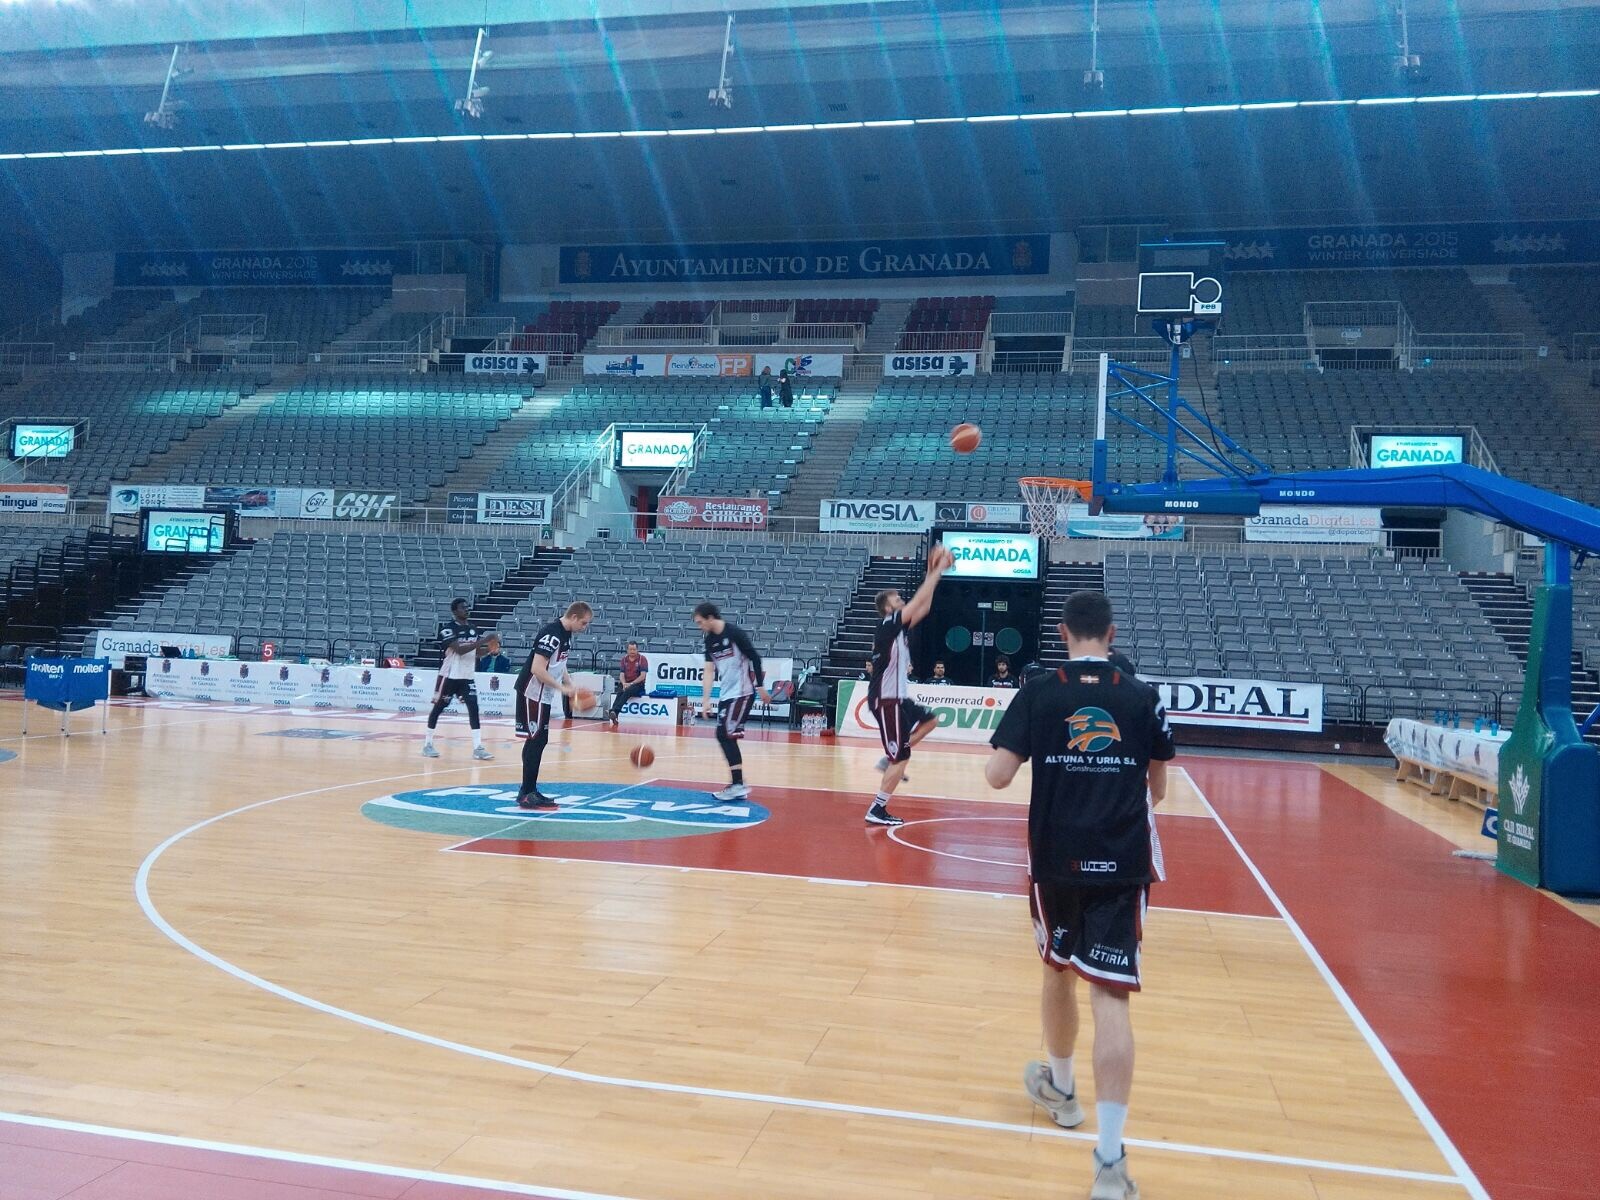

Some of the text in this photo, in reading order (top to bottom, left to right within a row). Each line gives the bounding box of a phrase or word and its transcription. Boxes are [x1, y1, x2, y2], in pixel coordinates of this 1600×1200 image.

[1308, 231, 1458, 248] GRANADA 2015
[212, 257, 281, 269] GRANADA
[610, 246, 991, 277] AYUNTAMIENTO DE GRANADA
[472, 356, 518, 370] asisa
[721, 358, 747, 374] FP
[892, 355, 944, 371] asisa
[19, 435, 69, 446] GRANADA
[627, 443, 688, 455] GRANADA
[1377, 449, 1455, 462] GRANADA
[705, 502, 761, 512] Restaurante
[1164, 500, 1199, 508] MONDO
[702, 509, 764, 524] CHIKITO
[938, 507, 962, 520] CV
[1250, 514, 1376, 527] GranadaDigital.es
[153, 524, 219, 539] GRANADA
[951, 547, 1031, 562] GRANADA
[263, 644, 273, 657] 5
[31, 663, 64, 674] molten
[73, 663, 105, 674] molten
[1045, 755, 1084, 764] ALTUNA
[1086, 756, 1094, 764] Y
[1096, 756, 1121, 765] URIA
[1065, 764, 1120, 773] Construcciones
[1088, 948, 1129, 967] AZTIRIA
